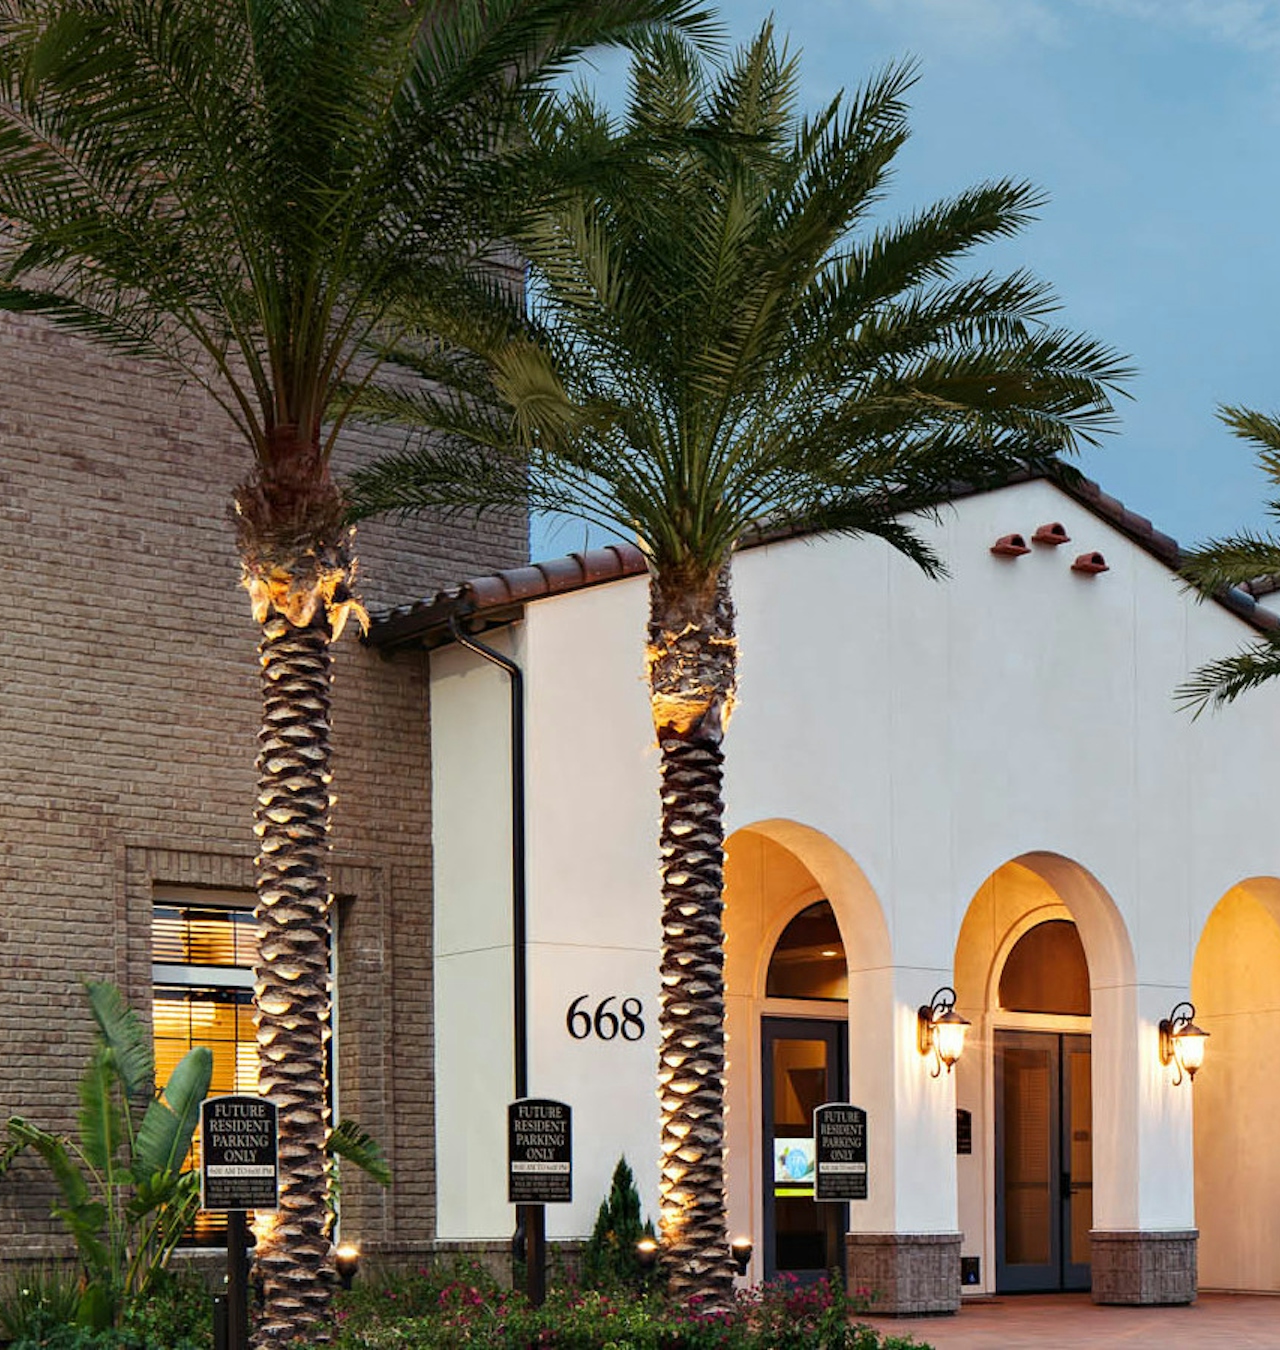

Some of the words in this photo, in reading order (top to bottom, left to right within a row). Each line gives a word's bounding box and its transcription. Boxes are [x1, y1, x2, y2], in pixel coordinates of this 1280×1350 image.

[566, 994, 644, 1041] 668
[214, 1104, 266, 1118] FUTURE
[518, 1106, 563, 1118] FUTURE
[824, 1111, 860, 1122] FUTURE
[209, 1120, 272, 1133] RESIDENT
[514, 1120, 567, 1133] RESIDENT
[821, 1124, 864, 1135] RESIDENT
[212, 1134, 270, 1147] PARKING
[516, 1134, 564, 1146] PARKING
[822, 1136, 861, 1148] PARKING
[224, 1150, 258, 1162] ONLY
[526, 1147, 555, 1160] ONLY
[830, 1149, 855, 1160] ONLY
